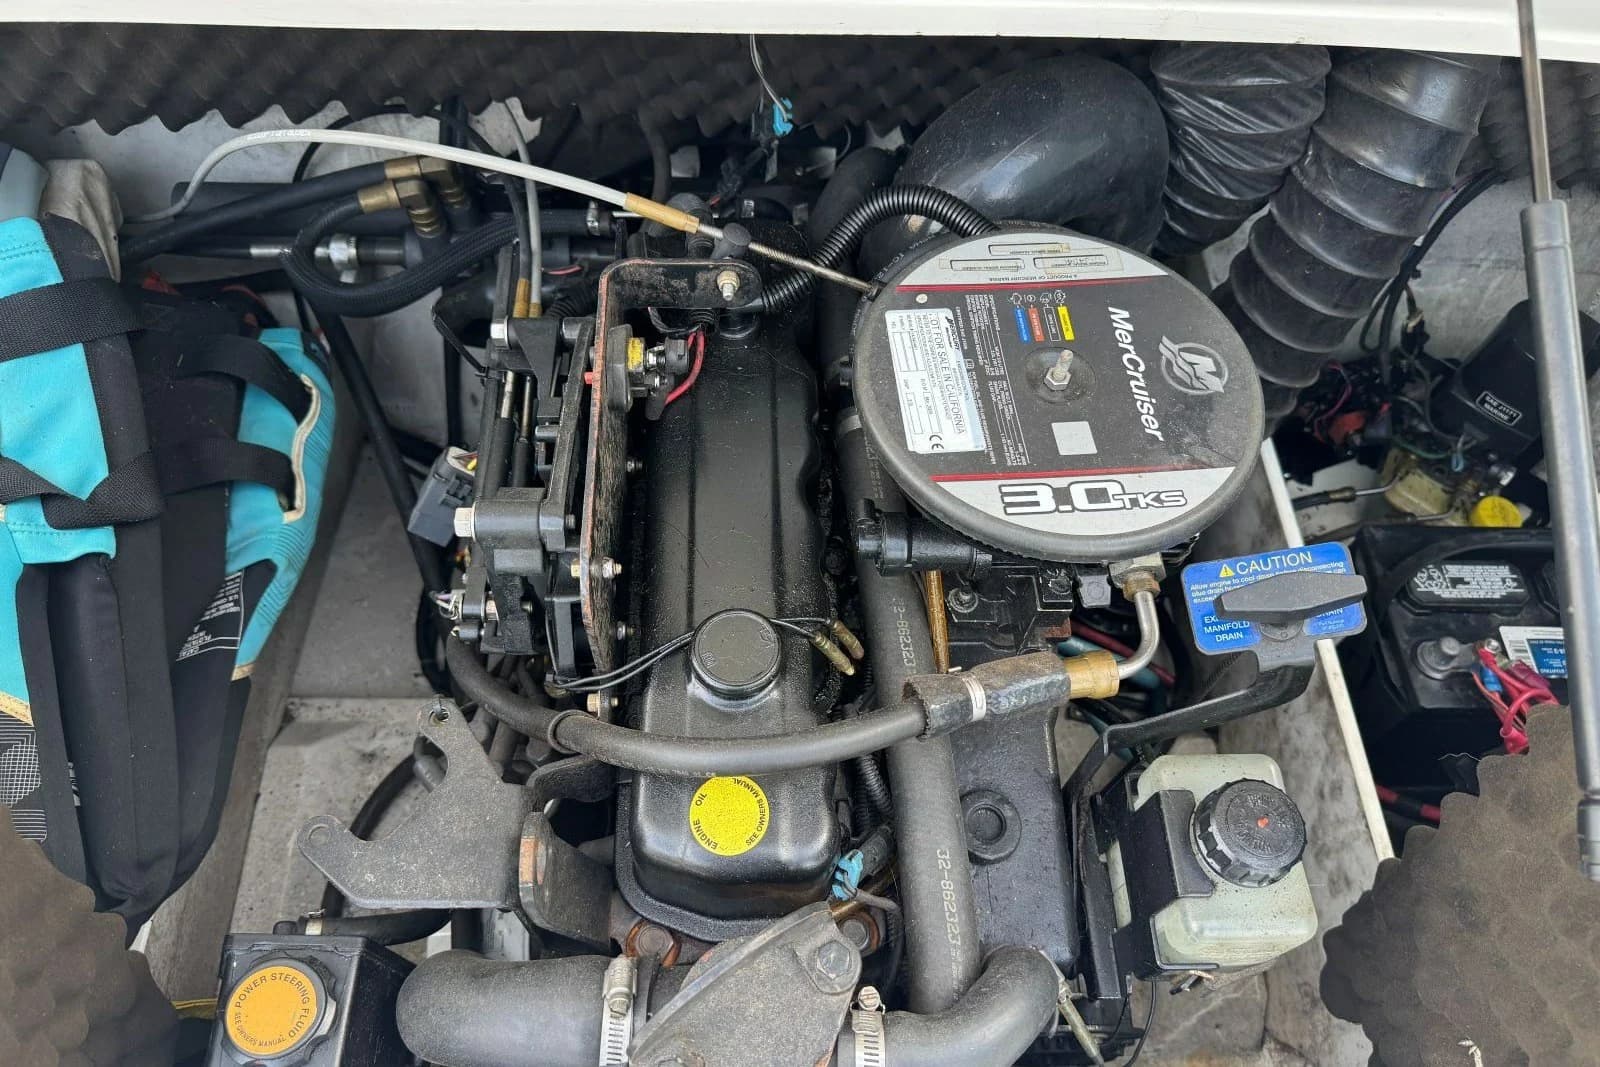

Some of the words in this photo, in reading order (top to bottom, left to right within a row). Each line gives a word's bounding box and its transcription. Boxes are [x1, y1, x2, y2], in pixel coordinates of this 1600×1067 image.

[933, 331, 945, 349] FOR
[937, 350, 949, 371] SALE
[942, 373, 952, 381] IN
[1106, 306, 1165, 442] MerCruiser
[945, 383, 965, 434] CALIFORNIA
[1483, 402, 1508, 420] MARINE
[928, 433, 944, 450] CE
[1236, 552, 1312, 575] CAUTION
[1203, 620, 1250, 634] MANIFOLD
[1216, 632, 1243, 642] DRAIN
[732, 778, 761, 798] MANUAL
[695, 793, 707, 806] OIL
[757, 799, 765, 832] OWNERS
[693, 818, 718, 849] ENGINE
[746, 832, 759, 846] SEE
[935, 847, 962, 945] 32-862323
[235, 975, 268, 1008] POWER
[270, 973, 310, 1005] STEERING
[289, 1008, 310, 1038] FLUID
[260, 1035, 286, 1047] MANUAL
